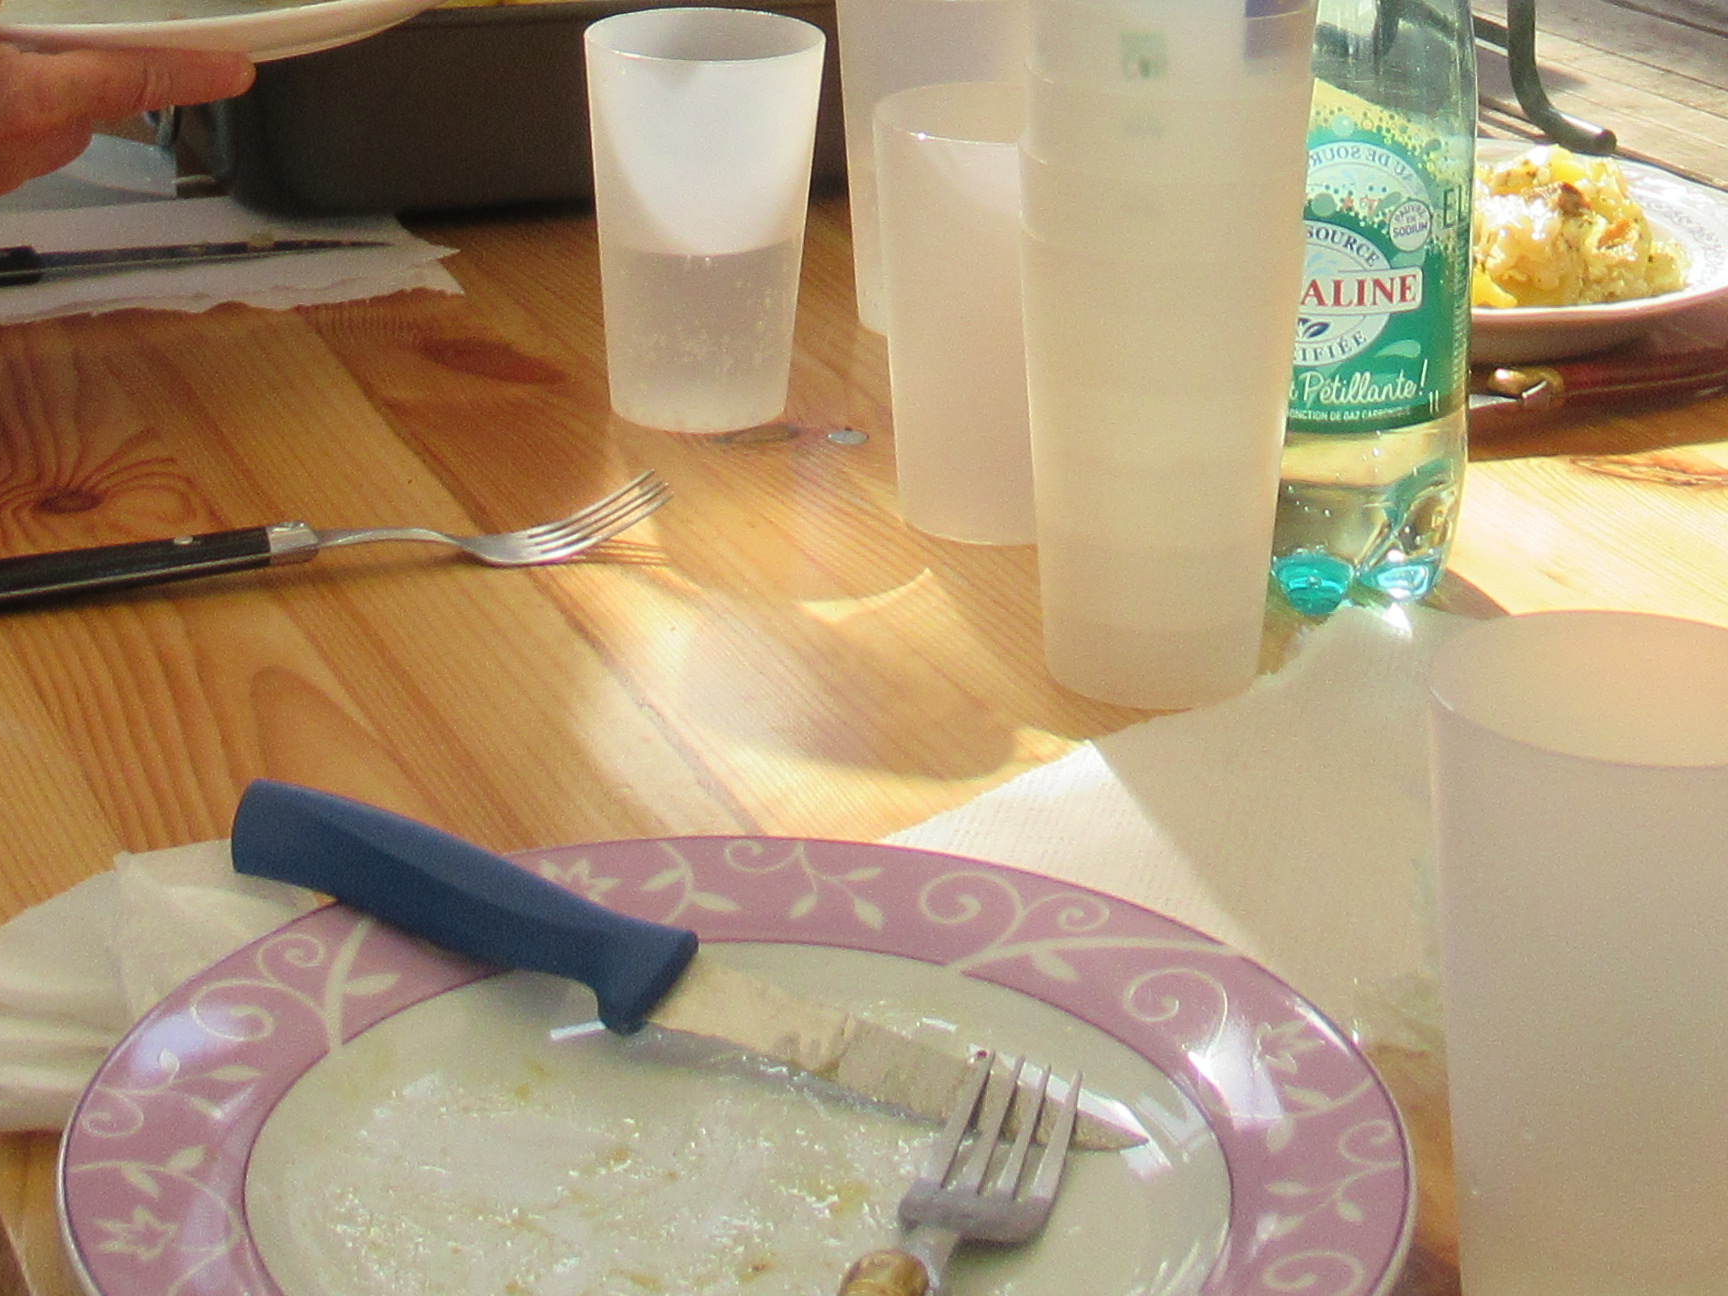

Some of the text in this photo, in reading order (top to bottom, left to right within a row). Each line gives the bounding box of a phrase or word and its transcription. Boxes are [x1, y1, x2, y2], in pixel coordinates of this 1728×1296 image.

[1393, 221, 1428, 238] SODIUM
[1300, 274, 1418, 307] ALINE
[1294, 330, 1368, 361] IFIÉE
